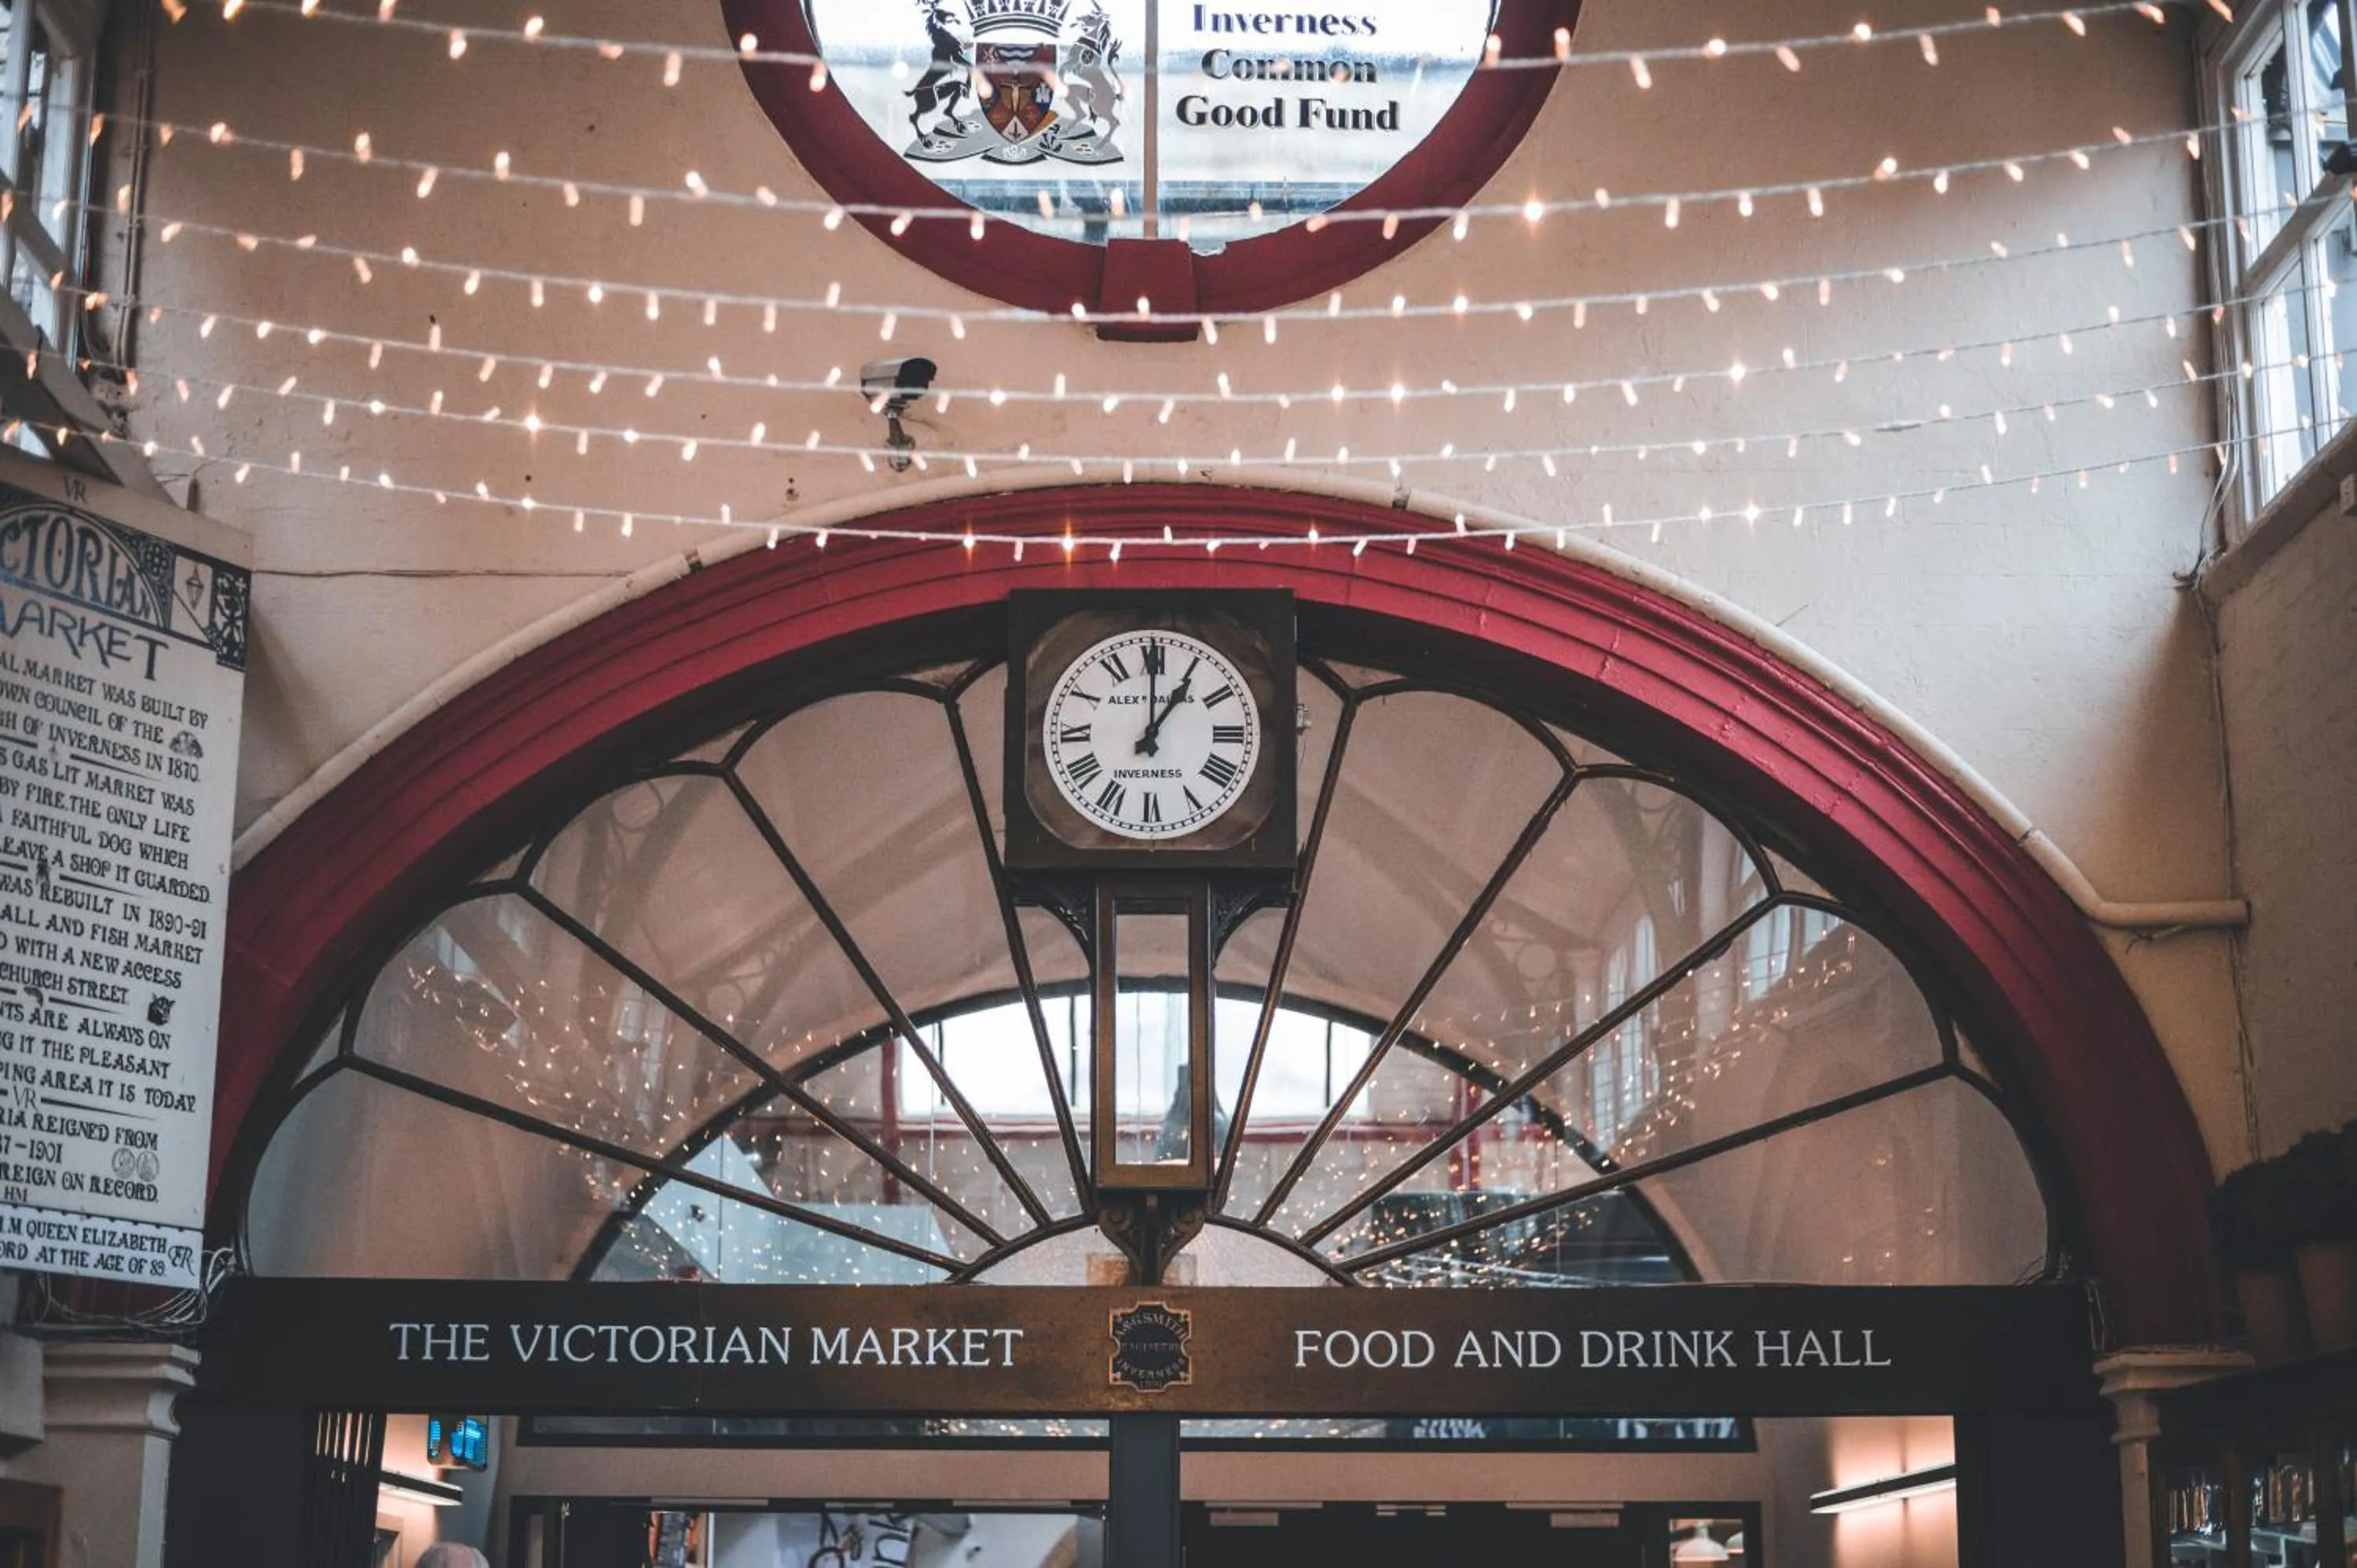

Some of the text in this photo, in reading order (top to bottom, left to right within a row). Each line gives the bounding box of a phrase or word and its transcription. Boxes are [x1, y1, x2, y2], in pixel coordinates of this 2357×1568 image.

[1193, 4, 1378, 36] Inverness
[1201, 48, 1376, 82] Common
[1176, 94, 1399, 130] Good Fund
[63, 475, 88, 504] VR
[23, 658, 96, 696] MARKET
[102, 683, 136, 708] WAS
[141, 694, 185, 723] BUILT
[189, 709, 208, 730] BY
[34, 691, 103, 727] COUNCIL
[108, 712, 128, 732] OF
[132, 720, 164, 745] THE
[23, 715, 43, 737] OF
[48, 723, 141, 767] INVERNESS
[145, 752, 163, 773] IN
[12, 749, 48, 777] GAS
[53, 761, 81, 784] LIT
[85, 771, 156, 806] MARKET
[161, 791, 196, 816] WAS
[1113, 769, 1182, 779] INVERNESS
[0, 776, 20, 797] BY
[107, 805, 148, 830] ONLY
[153, 819, 191, 844] LIFE
[0, 835, 48, 864] EAVE
[51, 849, 64, 868] A
[70, 852, 111, 877] SHOP
[115, 864, 131, 884] IT
[12, 808, 92, 845] FAITHFUL
[99, 830, 133, 855] DOG
[138, 841, 189, 870] WHICH
[0, 873, 207, 940] WAS REBUILT IN 1890-91
[45, 914, 85, 937] AND
[90, 923, 129, 949] FISH
[134, 933, 204, 965] MARKET
[0, 962, 64, 992] CHURCH
[15, 935, 57, 962] WITH
[61, 947, 75, 965] A
[80, 950, 119, 974] NEW
[121, 960, 182, 989] ACCESS
[28, 1007, 68, 1031] ARE
[77, 1017, 144, 1046] ALWAYS
[148, 1030, 171, 1051] ON
[0, 1031, 171, 1079] G IT THE PLEASANT
[13, 1085, 38, 1111] VR
[39, 1069, 93, 1095] AREA
[98, 1079, 114, 1098] IT
[119, 1083, 136, 1103] IS
[32, 1113, 109, 1143] REIGNED
[114, 1127, 159, 1152] FROM
[0, 1162, 56, 1189] REIGN
[62, 1171, 84, 1192] ON
[26, 1218, 77, 1243] QUEEN
[82, 1227, 167, 1254] ELIZABETH
[35, 1247, 58, 1265] AT
[61, 1250, 90, 1268] THE
[93, 1254, 124, 1272] AGE
[128, 1257, 148, 1276] OF
[389, 1324, 1025, 1367] THE VICTORIAN MARKET
[1294, 1330, 1891, 1368] FOOD AND DRINK HALL
